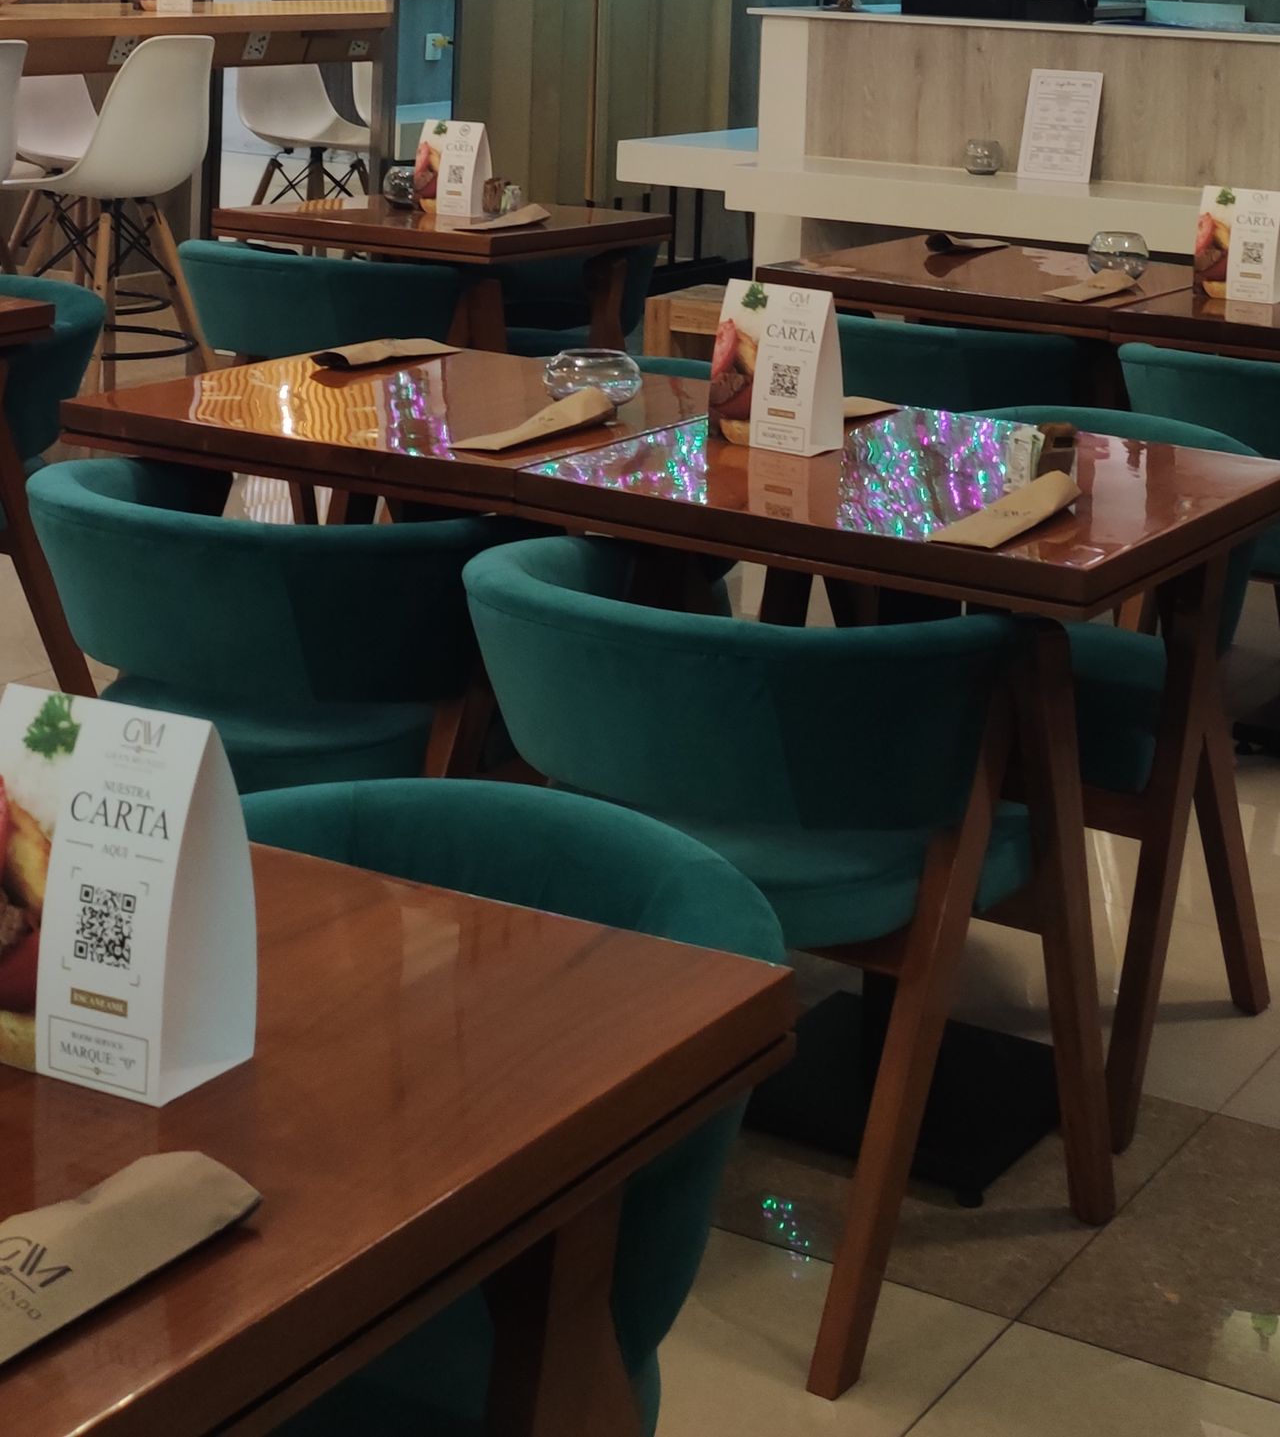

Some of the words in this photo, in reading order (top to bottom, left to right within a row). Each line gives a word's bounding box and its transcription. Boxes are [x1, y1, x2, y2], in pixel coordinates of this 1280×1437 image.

[1235, 214, 1276, 228] CARTA
[766, 323, 817, 344] CARTA
[104, 780, 152, 800] NUESTRA
[70, 790, 170, 840] CARTA
